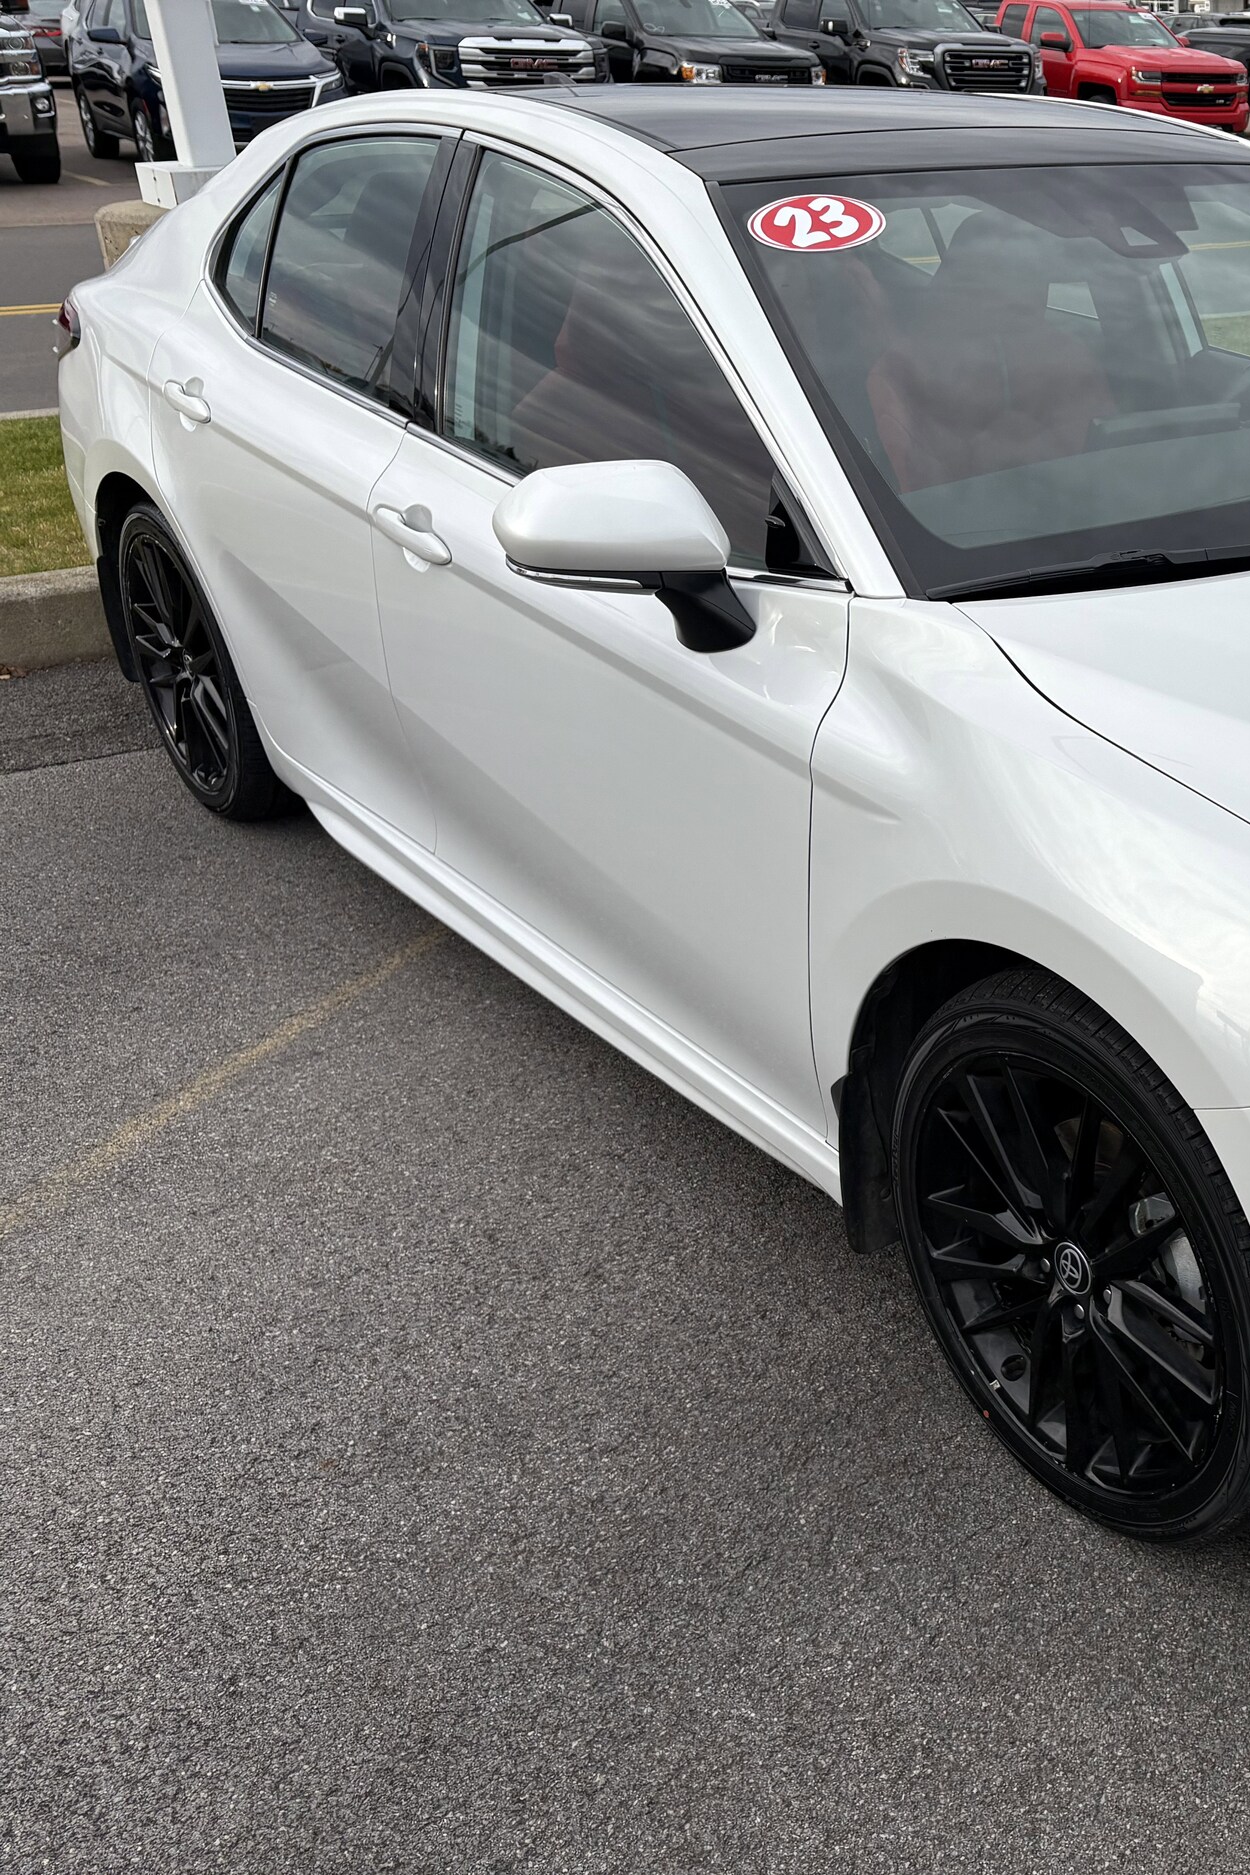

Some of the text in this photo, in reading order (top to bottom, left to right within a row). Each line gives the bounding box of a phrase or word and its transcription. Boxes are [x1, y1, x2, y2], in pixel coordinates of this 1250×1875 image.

[511, 57, 559, 70] GMC
[972, 59, 1008, 69] GMC
[773, 197, 860, 248] 23
